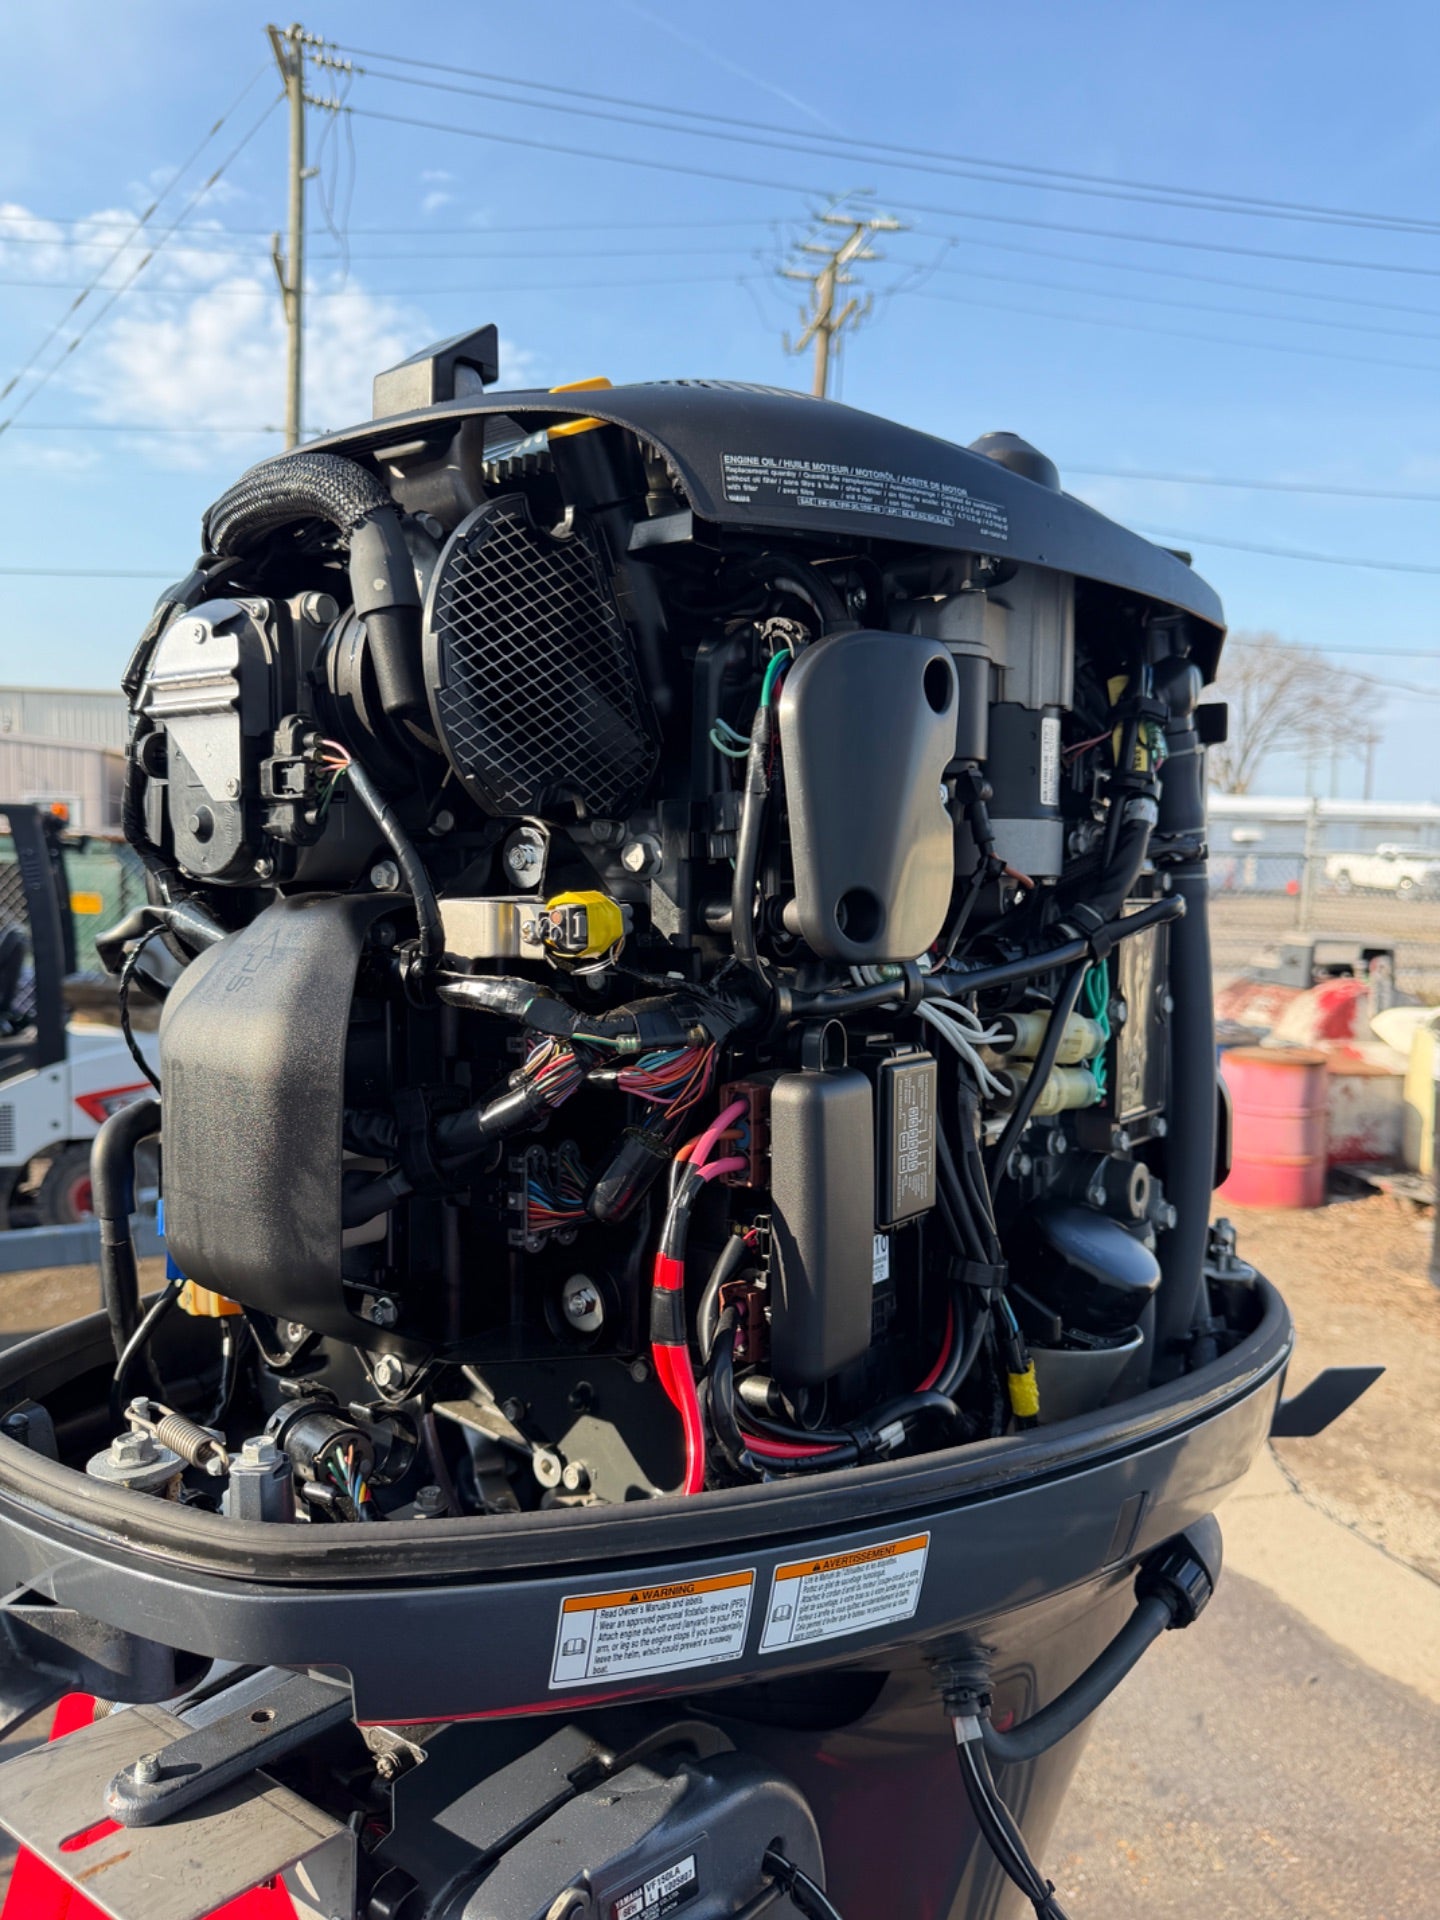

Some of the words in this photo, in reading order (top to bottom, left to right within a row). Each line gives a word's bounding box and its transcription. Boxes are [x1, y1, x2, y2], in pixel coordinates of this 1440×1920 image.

[724, 455, 759, 465] ENGINE
[761, 458, 776, 466] OIL
[783, 460, 810, 470] HUILE
[812, 462, 848, 475] MOTEUR
[901, 476, 927, 488] ACEITE
[929, 482, 939, 490] DE
[941, 484, 968, 497] MOTOR
[225, 975, 253, 992] UP
[823, 1545, 896, 1569] AVERTISSEMENT
[642, 1585, 695, 1599] WARNING
[599, 1620, 616, 1630] Wear
[626, 1615, 656, 1628] approved
[656, 1610, 683, 1624] personal
[684, 1606, 709, 1617] flotation
[710, 1603, 729, 1612] device
[600, 1609, 618, 1619] Read
[618, 1605, 645, 1616] Owner's
[645, 1601, 672, 1612] Manuals
[672, 1599, 684, 1608] and
[597, 1631, 618, 1642] Attach
[619, 1630, 641, 1641] engine
[642, 1625, 667, 1635] shut-off
[667, 1622, 681, 1631] cord
[682, 1617, 708, 1630] (lanyard)
[716, 1615, 730, 1625] your
[620, 1641, 630, 1651] leg
[640, 1638, 650, 1646] the
[651, 1635, 672, 1646] engine
[673, 1632, 690, 1643] stops
[695, 1630, 708, 1639] you
[709, 1622, 743, 1635] accidentally
[594, 1655, 612, 1664] leave
[612, 1653, 623, 1661] the
[642, 1648, 660, 1656] which
[661, 1644, 679, 1653] could
[679, 1640, 703, 1652] prevent
[708, 1636, 733, 1646] runaway
[615, 1887, 643, 1909] YAMAHA
